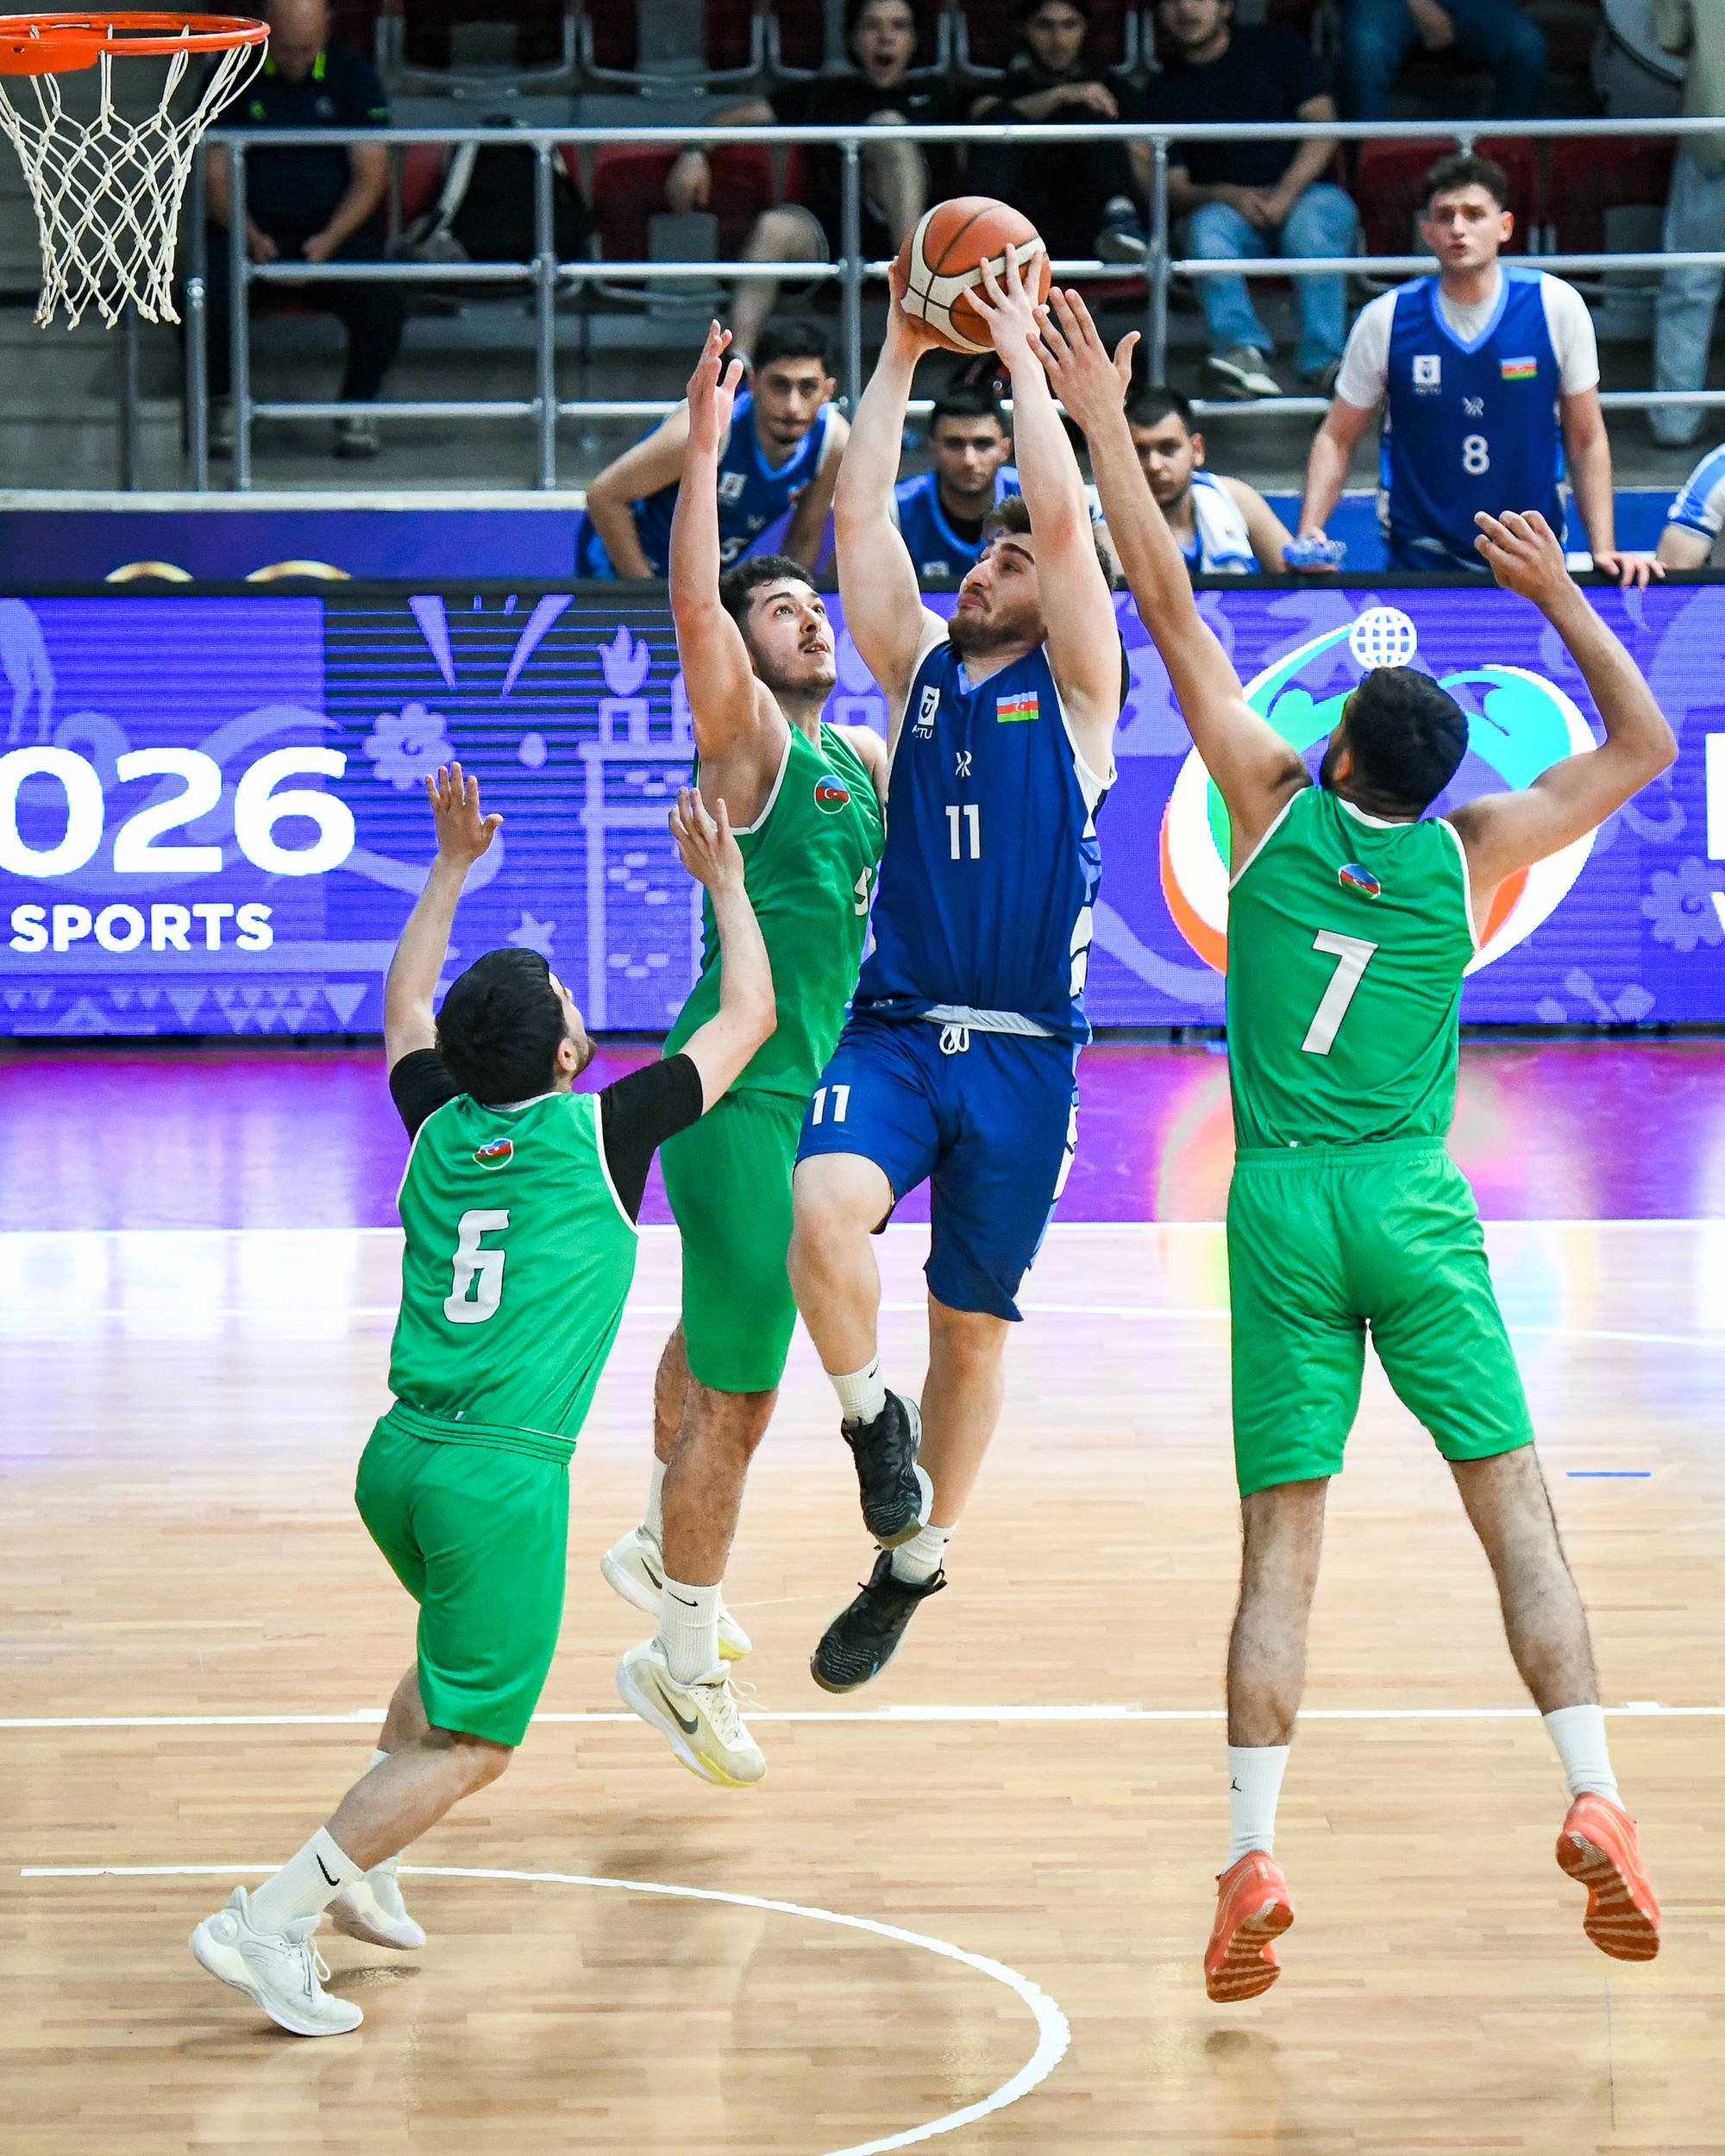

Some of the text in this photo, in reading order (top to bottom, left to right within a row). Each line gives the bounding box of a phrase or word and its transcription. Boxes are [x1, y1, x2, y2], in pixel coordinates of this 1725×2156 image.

[1463, 435, 1490, 475] 8
[0, 745, 355, 878] 026
[945, 804, 982, 861] 11
[9, 903, 273, 953] SPORTS
[1300, 927, 1380, 1056] 7
[812, 1084, 851, 1126] 11
[442, 1208, 511, 1325] 6
